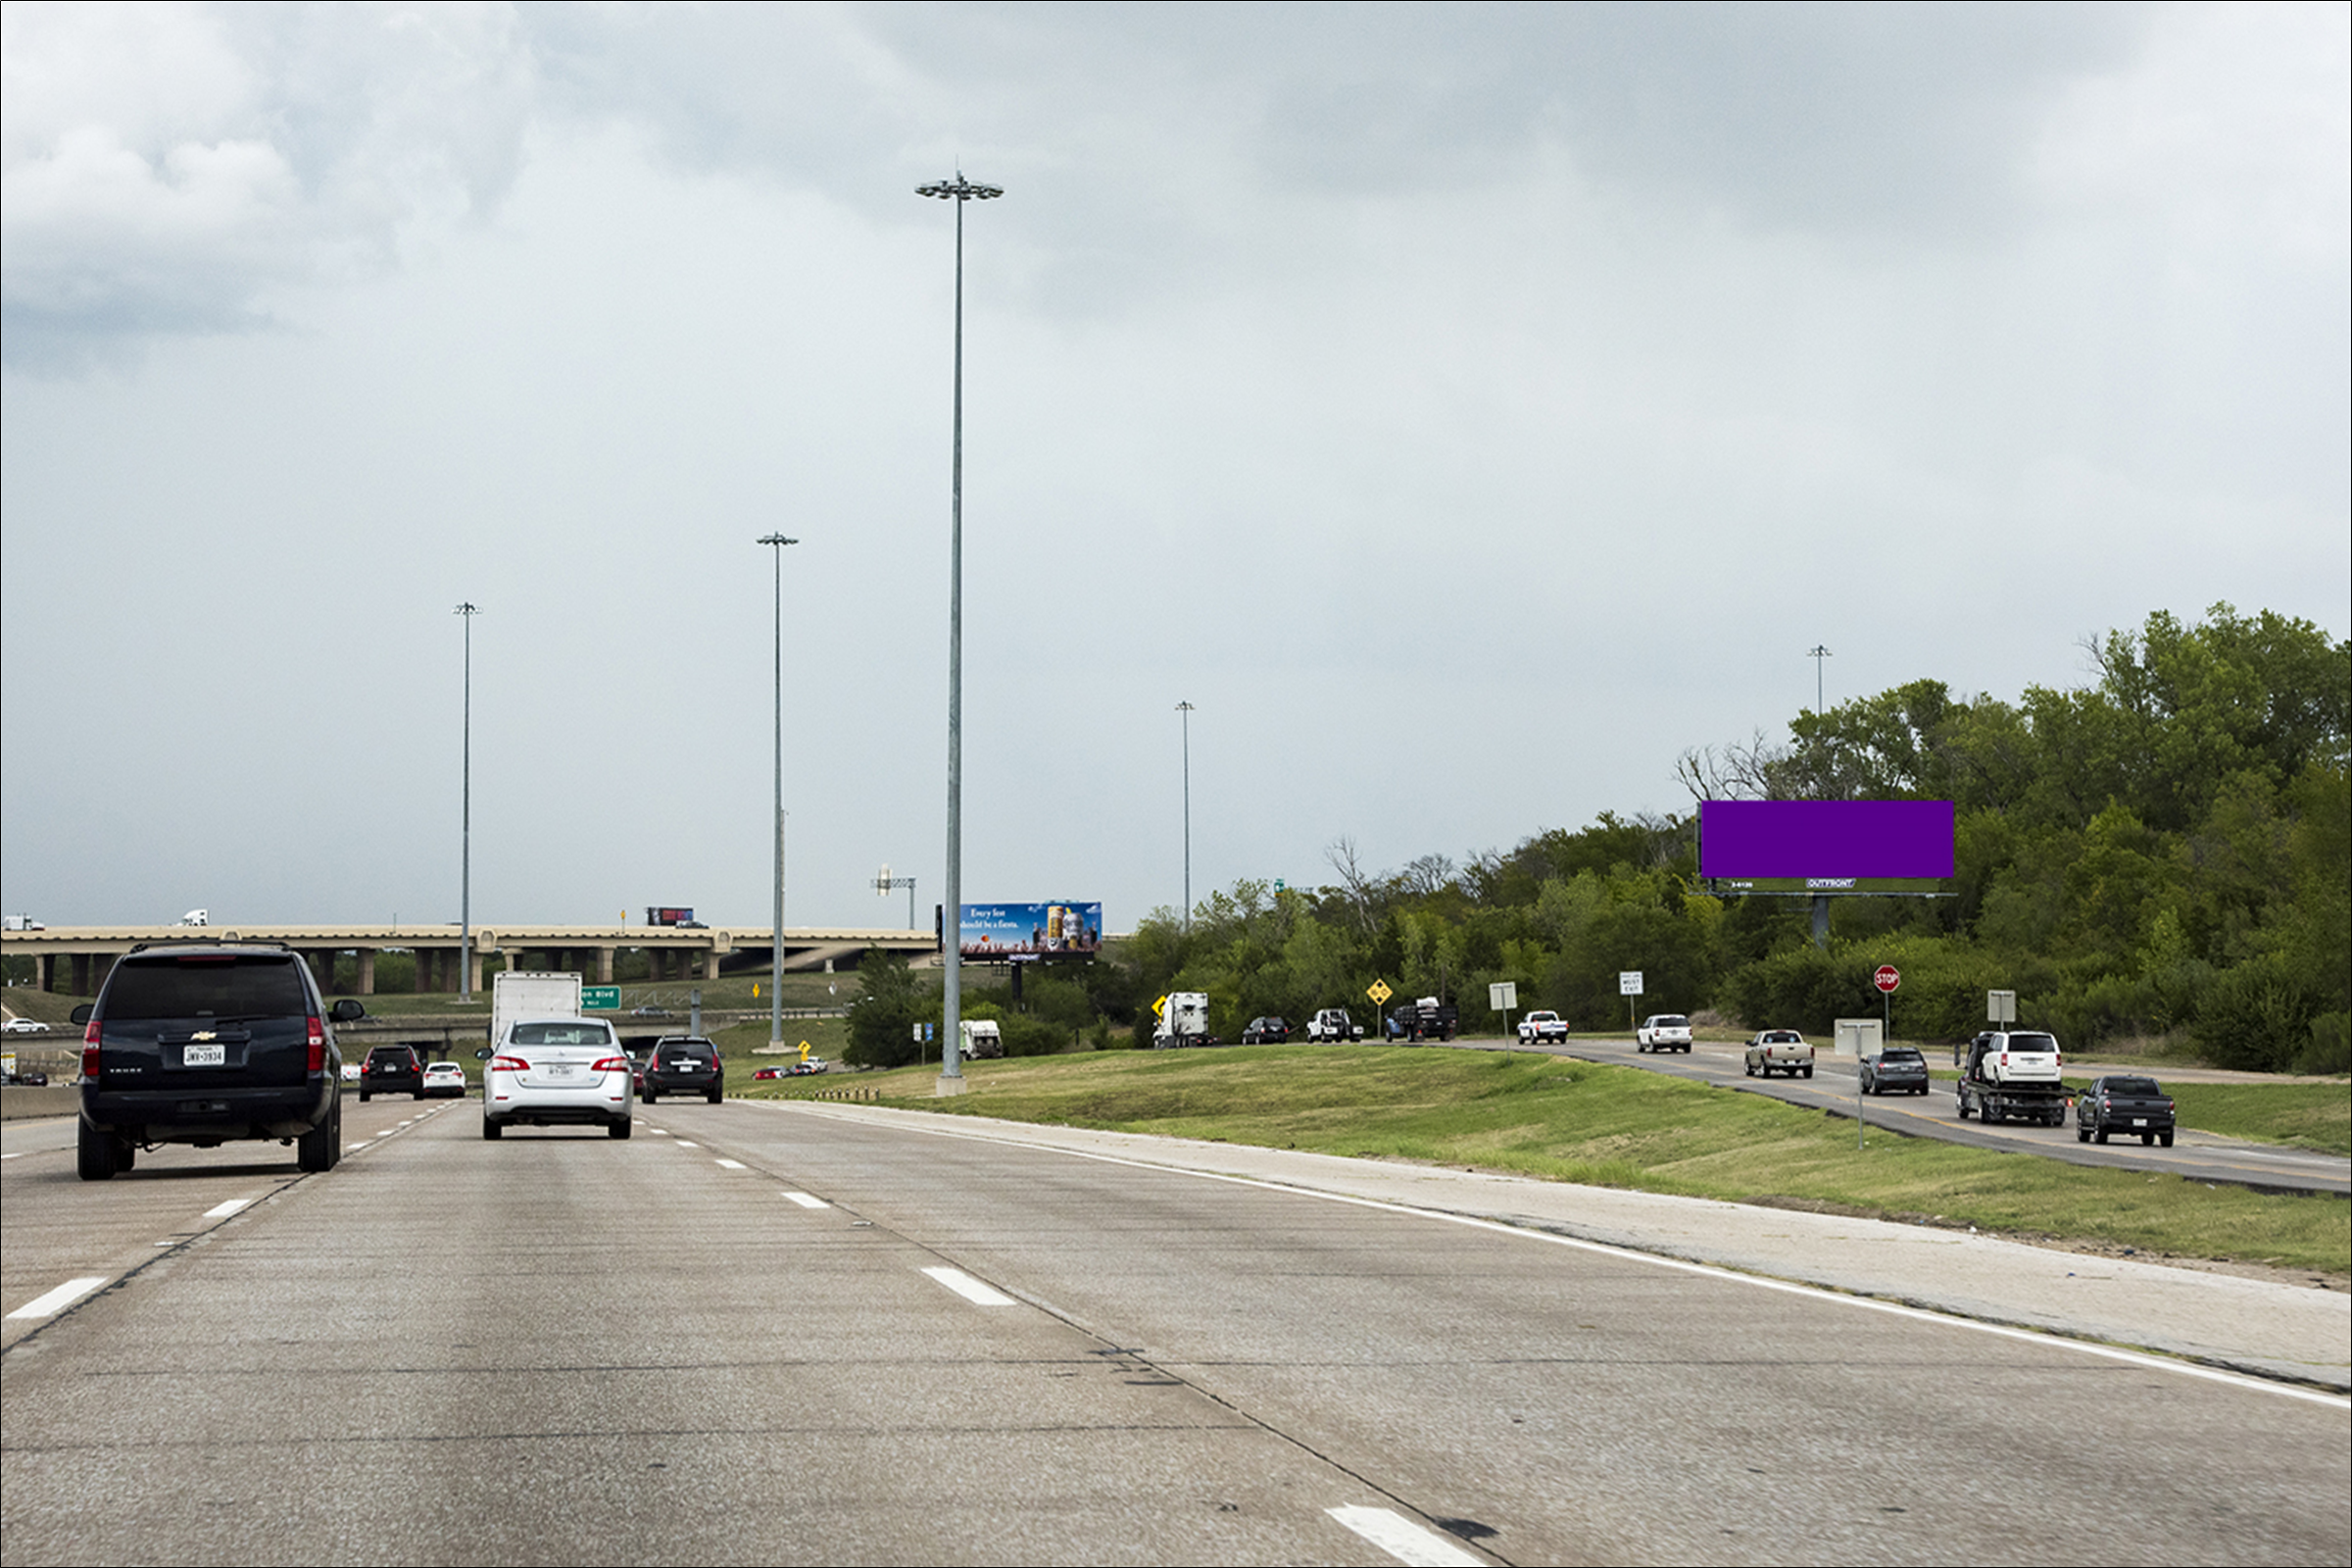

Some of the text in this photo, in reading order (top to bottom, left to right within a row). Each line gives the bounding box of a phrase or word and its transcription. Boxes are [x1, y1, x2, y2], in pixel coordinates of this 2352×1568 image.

[1807, 878, 1855, 887] OUTFRONT
[971, 907, 991, 919] Every
[984, 919, 992, 928] be
[1876, 973, 1898, 984] STOP
